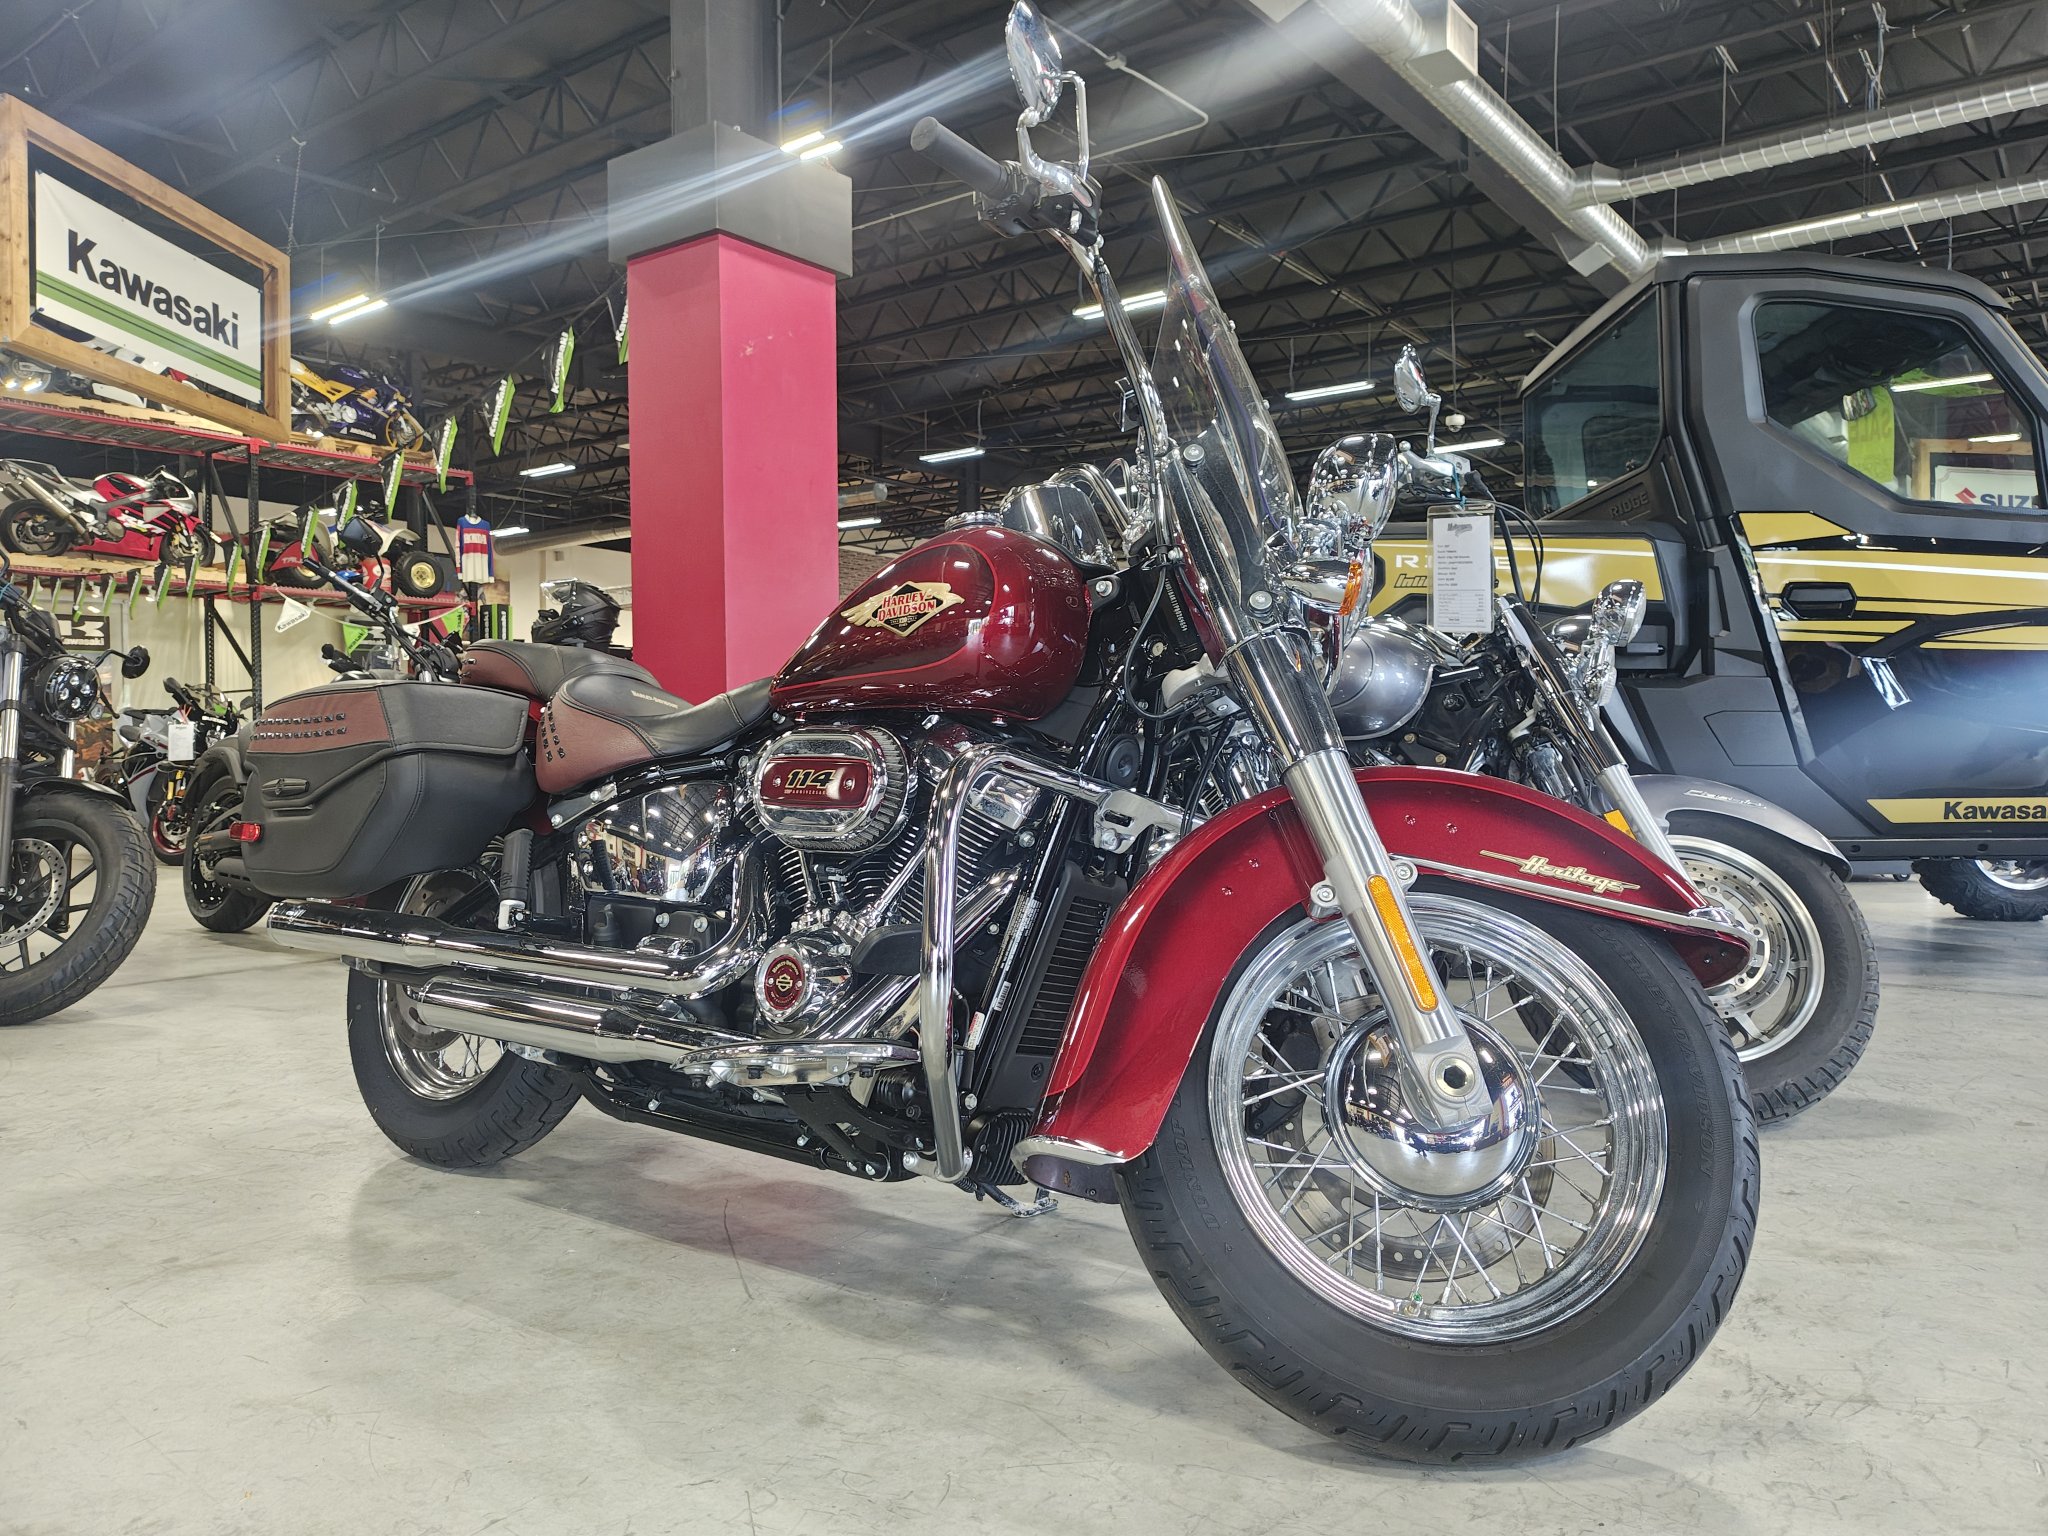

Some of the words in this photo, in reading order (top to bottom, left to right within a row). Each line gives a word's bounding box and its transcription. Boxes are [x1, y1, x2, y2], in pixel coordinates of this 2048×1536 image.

[68, 229, 239, 349] Kawasaki
[1610, 490, 1649, 517] RIDGE
[877, 600, 936, 622] DAVIDSON
[882, 591, 933, 609] HARLEY-
[785, 769, 835, 788] 114
[1943, 801, 2047, 819] Kawasa
[1518, 855, 1626, 893] Heritage
[1171, 1118, 1220, 1229] DUNLOP
